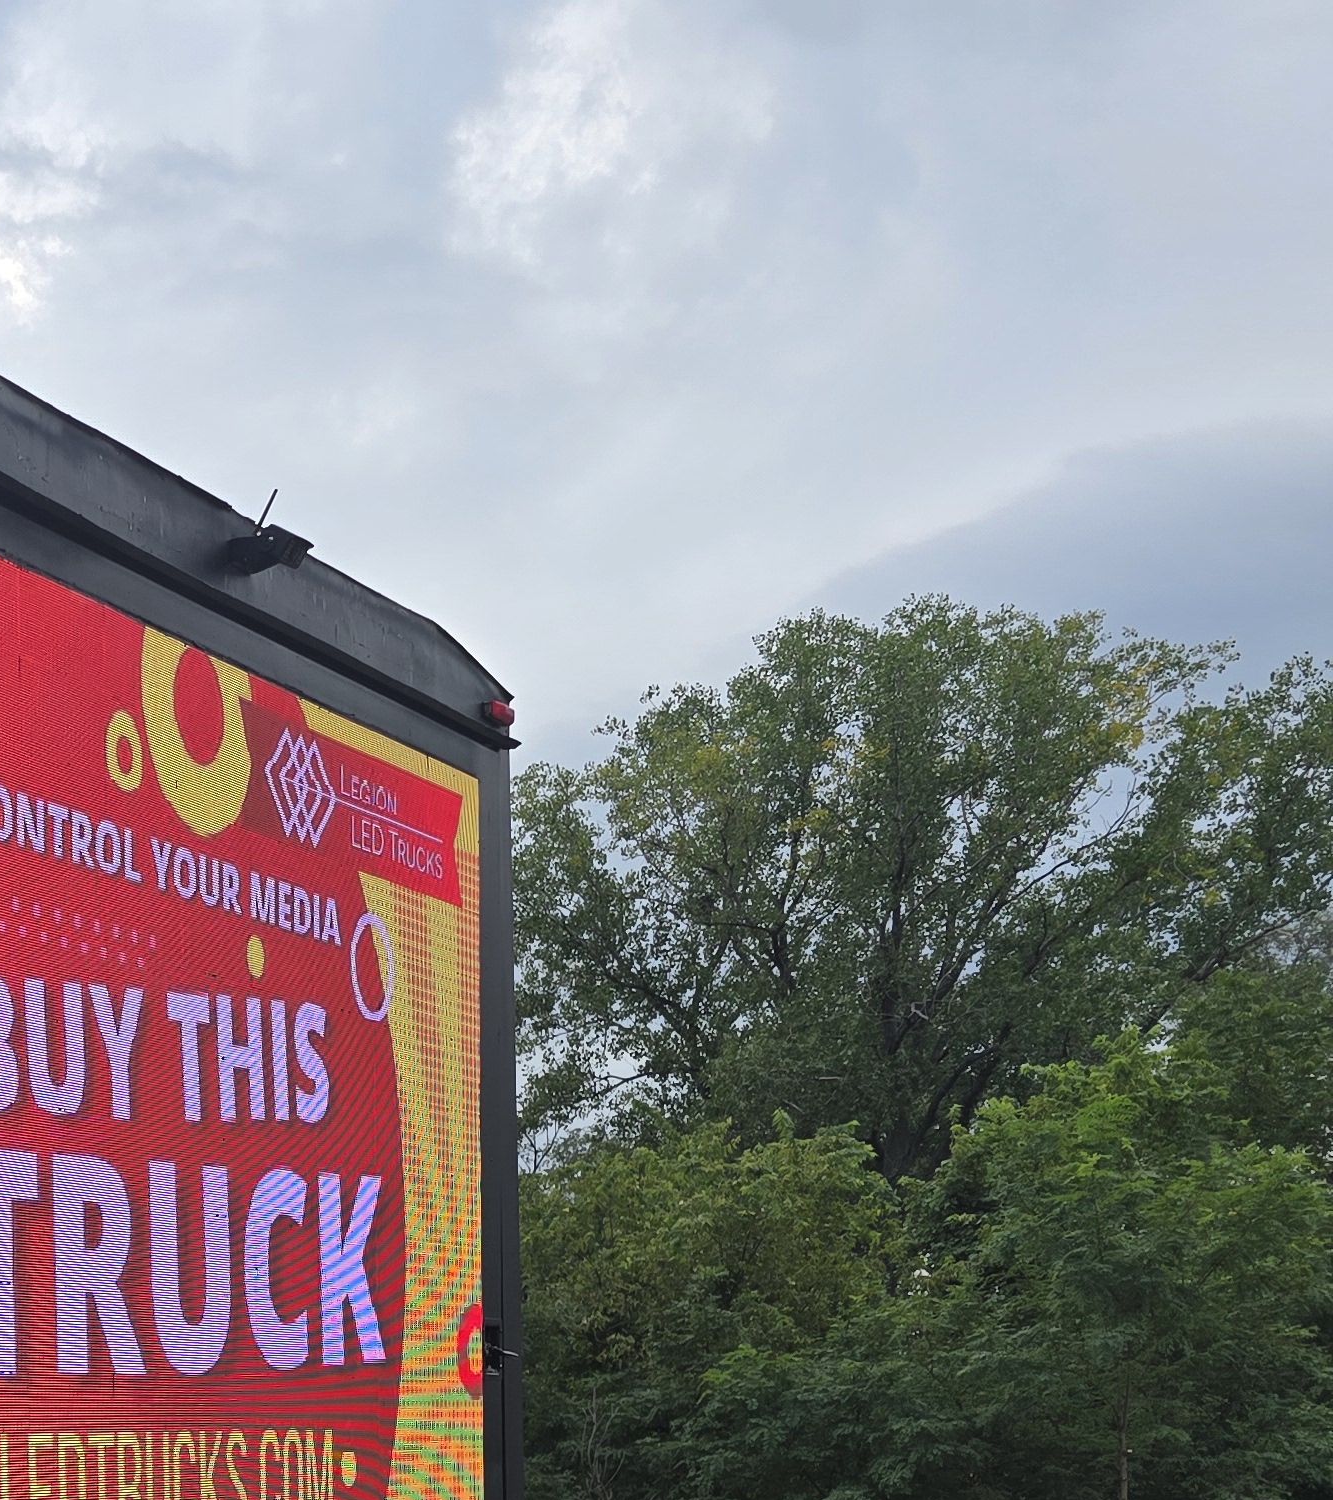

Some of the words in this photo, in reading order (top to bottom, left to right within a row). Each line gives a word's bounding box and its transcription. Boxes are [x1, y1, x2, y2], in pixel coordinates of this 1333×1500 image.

[339, 764, 398, 816] LEGION
[351, 815, 385, 857] LED
[388, 828, 444, 880] TRUCKS
[150, 837, 243, 916] YOUR
[250, 871, 342, 946] MEDIA
[165, 991, 331, 1124] THIS
